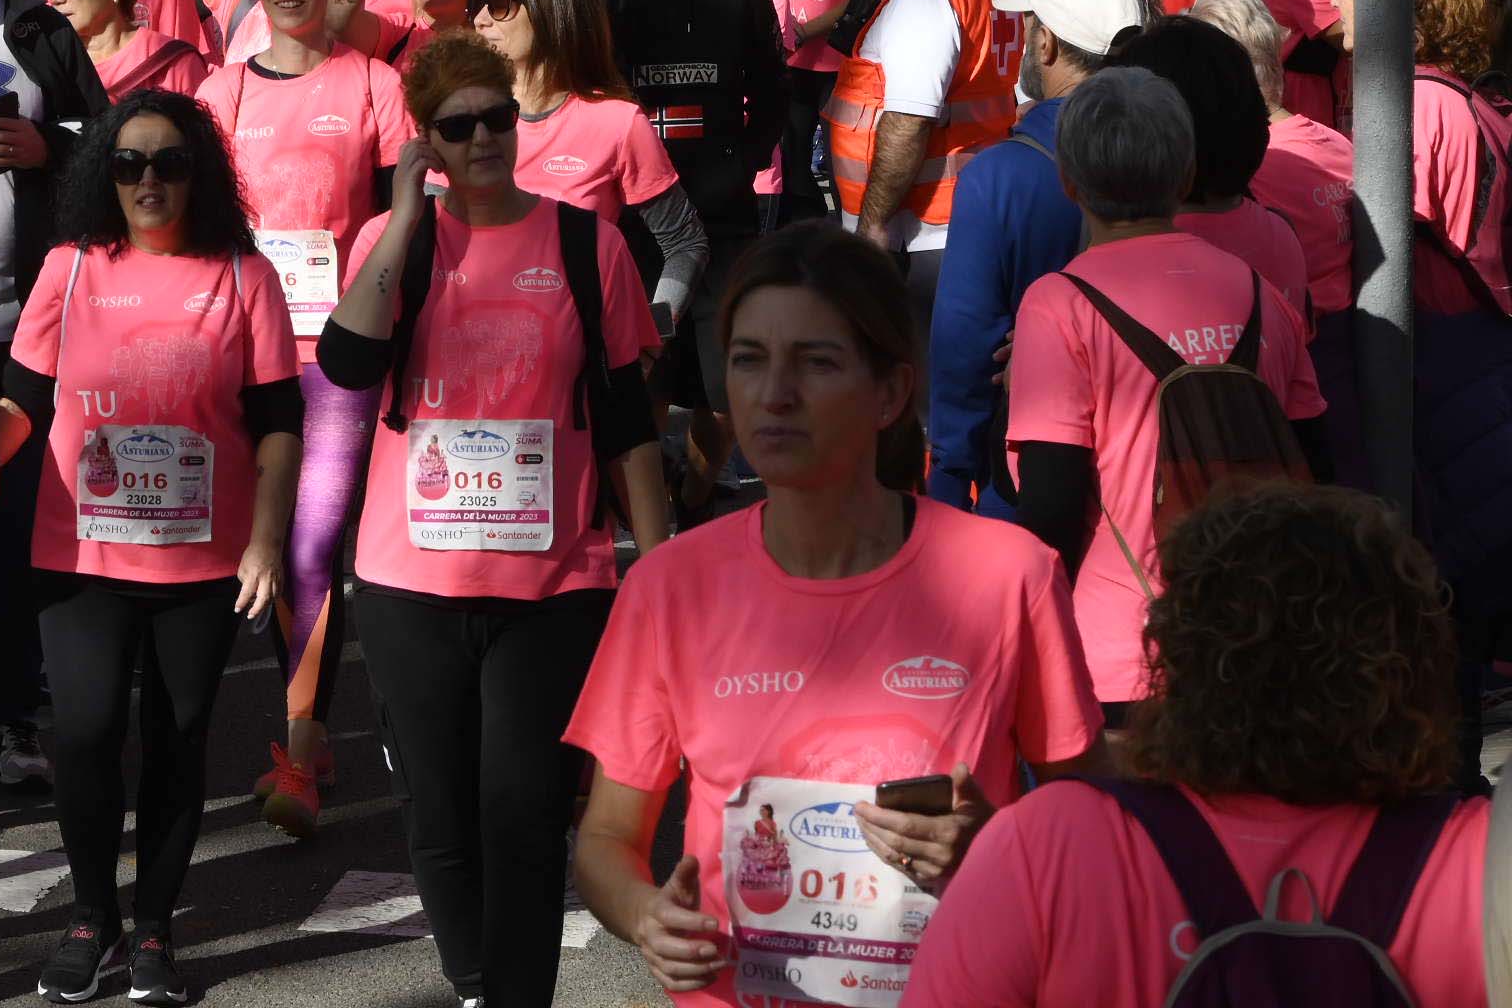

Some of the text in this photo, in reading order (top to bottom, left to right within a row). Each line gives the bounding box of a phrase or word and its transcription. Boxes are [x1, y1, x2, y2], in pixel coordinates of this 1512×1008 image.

[638, 66, 716, 85] NORWAY
[88, 295, 141, 308] OYSHO
[412, 378, 444, 409] TU
[76, 390, 117, 418] TU
[451, 437, 543, 454] ASTURIANA SUMA
[122, 472, 168, 490] 016
[455, 472, 503, 490] 016
[126, 494, 162, 505] 23028
[459, 496, 497, 507] 23025
[93, 507, 128, 517] CARRERA
[423, 512, 462, 521] CARRERA
[476, 512, 487, 520] LA
[488, 513, 517, 521] MUJER
[519, 513, 538, 521] 2023
[89, 522, 201, 535] OYSHO Santander
[421, 529, 542, 541] OYSHO Santander
[714, 669, 964, 699] OYSHO ASTURIANA
[798, 817, 864, 838] ASTURI
[799, 868, 879, 904] 016
[810, 911, 858, 932] 4349
[808, 940, 825, 952] DE
[827, 942, 844, 953] LA
[847, 943, 896, 958] MUJER
[901, 949, 915, 960] 20
[742, 961, 802, 984] OYSHO
